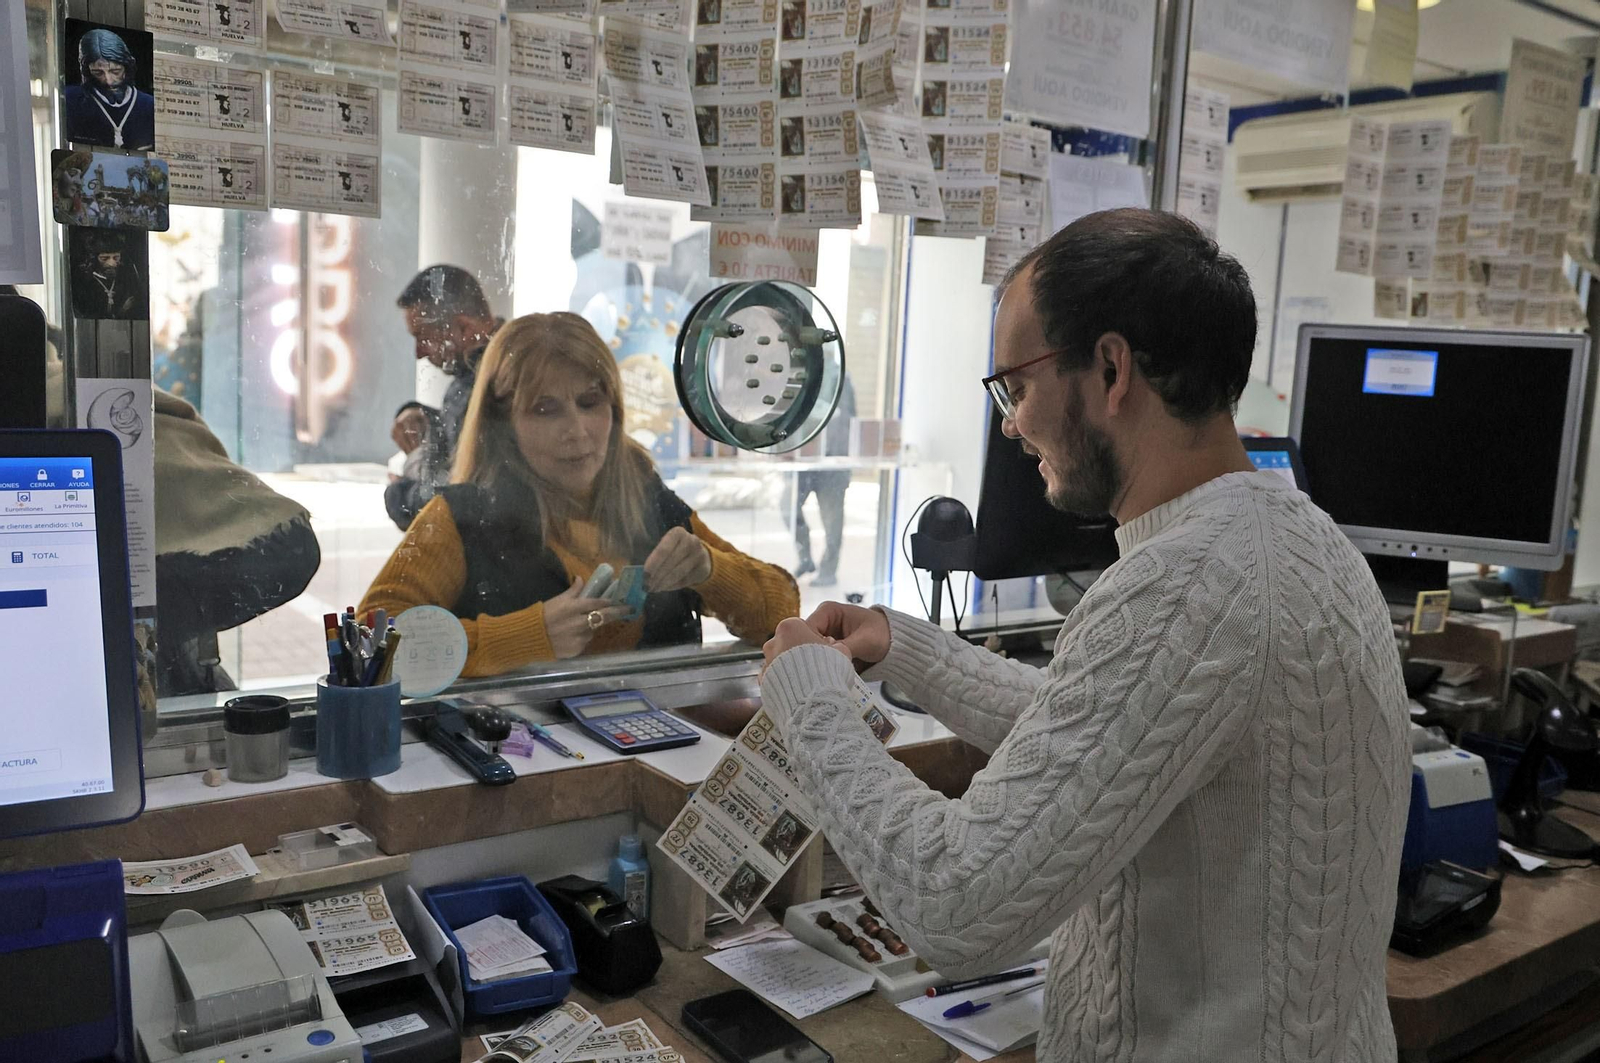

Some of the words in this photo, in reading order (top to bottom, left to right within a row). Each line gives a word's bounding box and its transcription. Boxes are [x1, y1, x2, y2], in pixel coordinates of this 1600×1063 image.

[244, 20, 250, 29] 2
[722, 45, 758, 55] 75460
[243, 108, 250, 118] 2
[722, 106, 758, 117] 75460
[721, 167, 759, 178] 75460
[245, 181, 253, 190] 2
[6, 521, 33, 530] clientes
[34, 521, 69, 529] atendidos:
[32, 552, 59, 560] TOTAL
[736, 793, 758, 812] NAVIDAD
[718, 796, 761, 836] 13687
[678, 847, 721, 887] 13687
[308, 894, 361, 908] 51965
[323, 934, 377, 948] 51965
